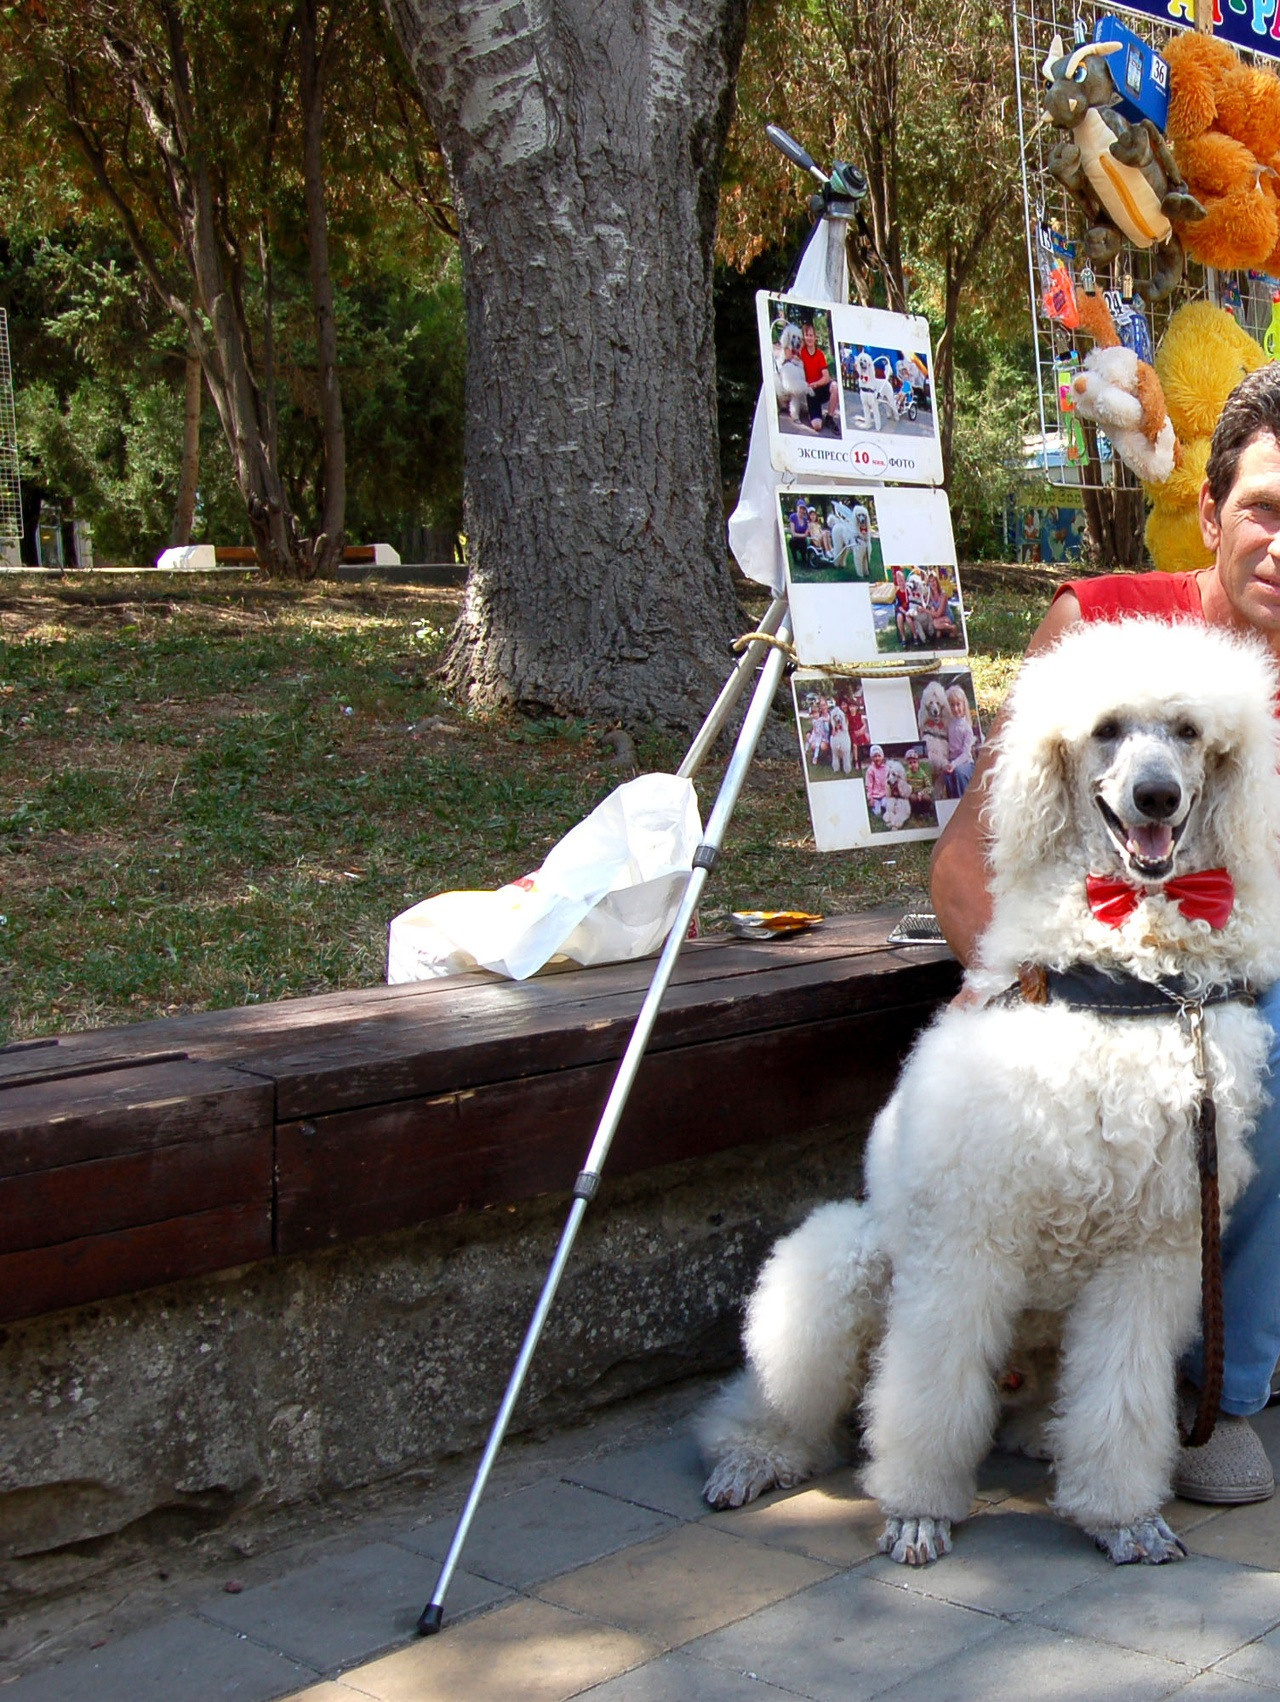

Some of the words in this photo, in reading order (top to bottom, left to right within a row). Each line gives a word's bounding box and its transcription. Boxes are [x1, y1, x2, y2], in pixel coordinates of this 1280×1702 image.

[1153, 59, 1166, 84] 36
[797, 446, 849, 462] ЭКСПРЕСС
[854, 450, 870, 464] 10
[888, 457, 915, 469] ФОТО
